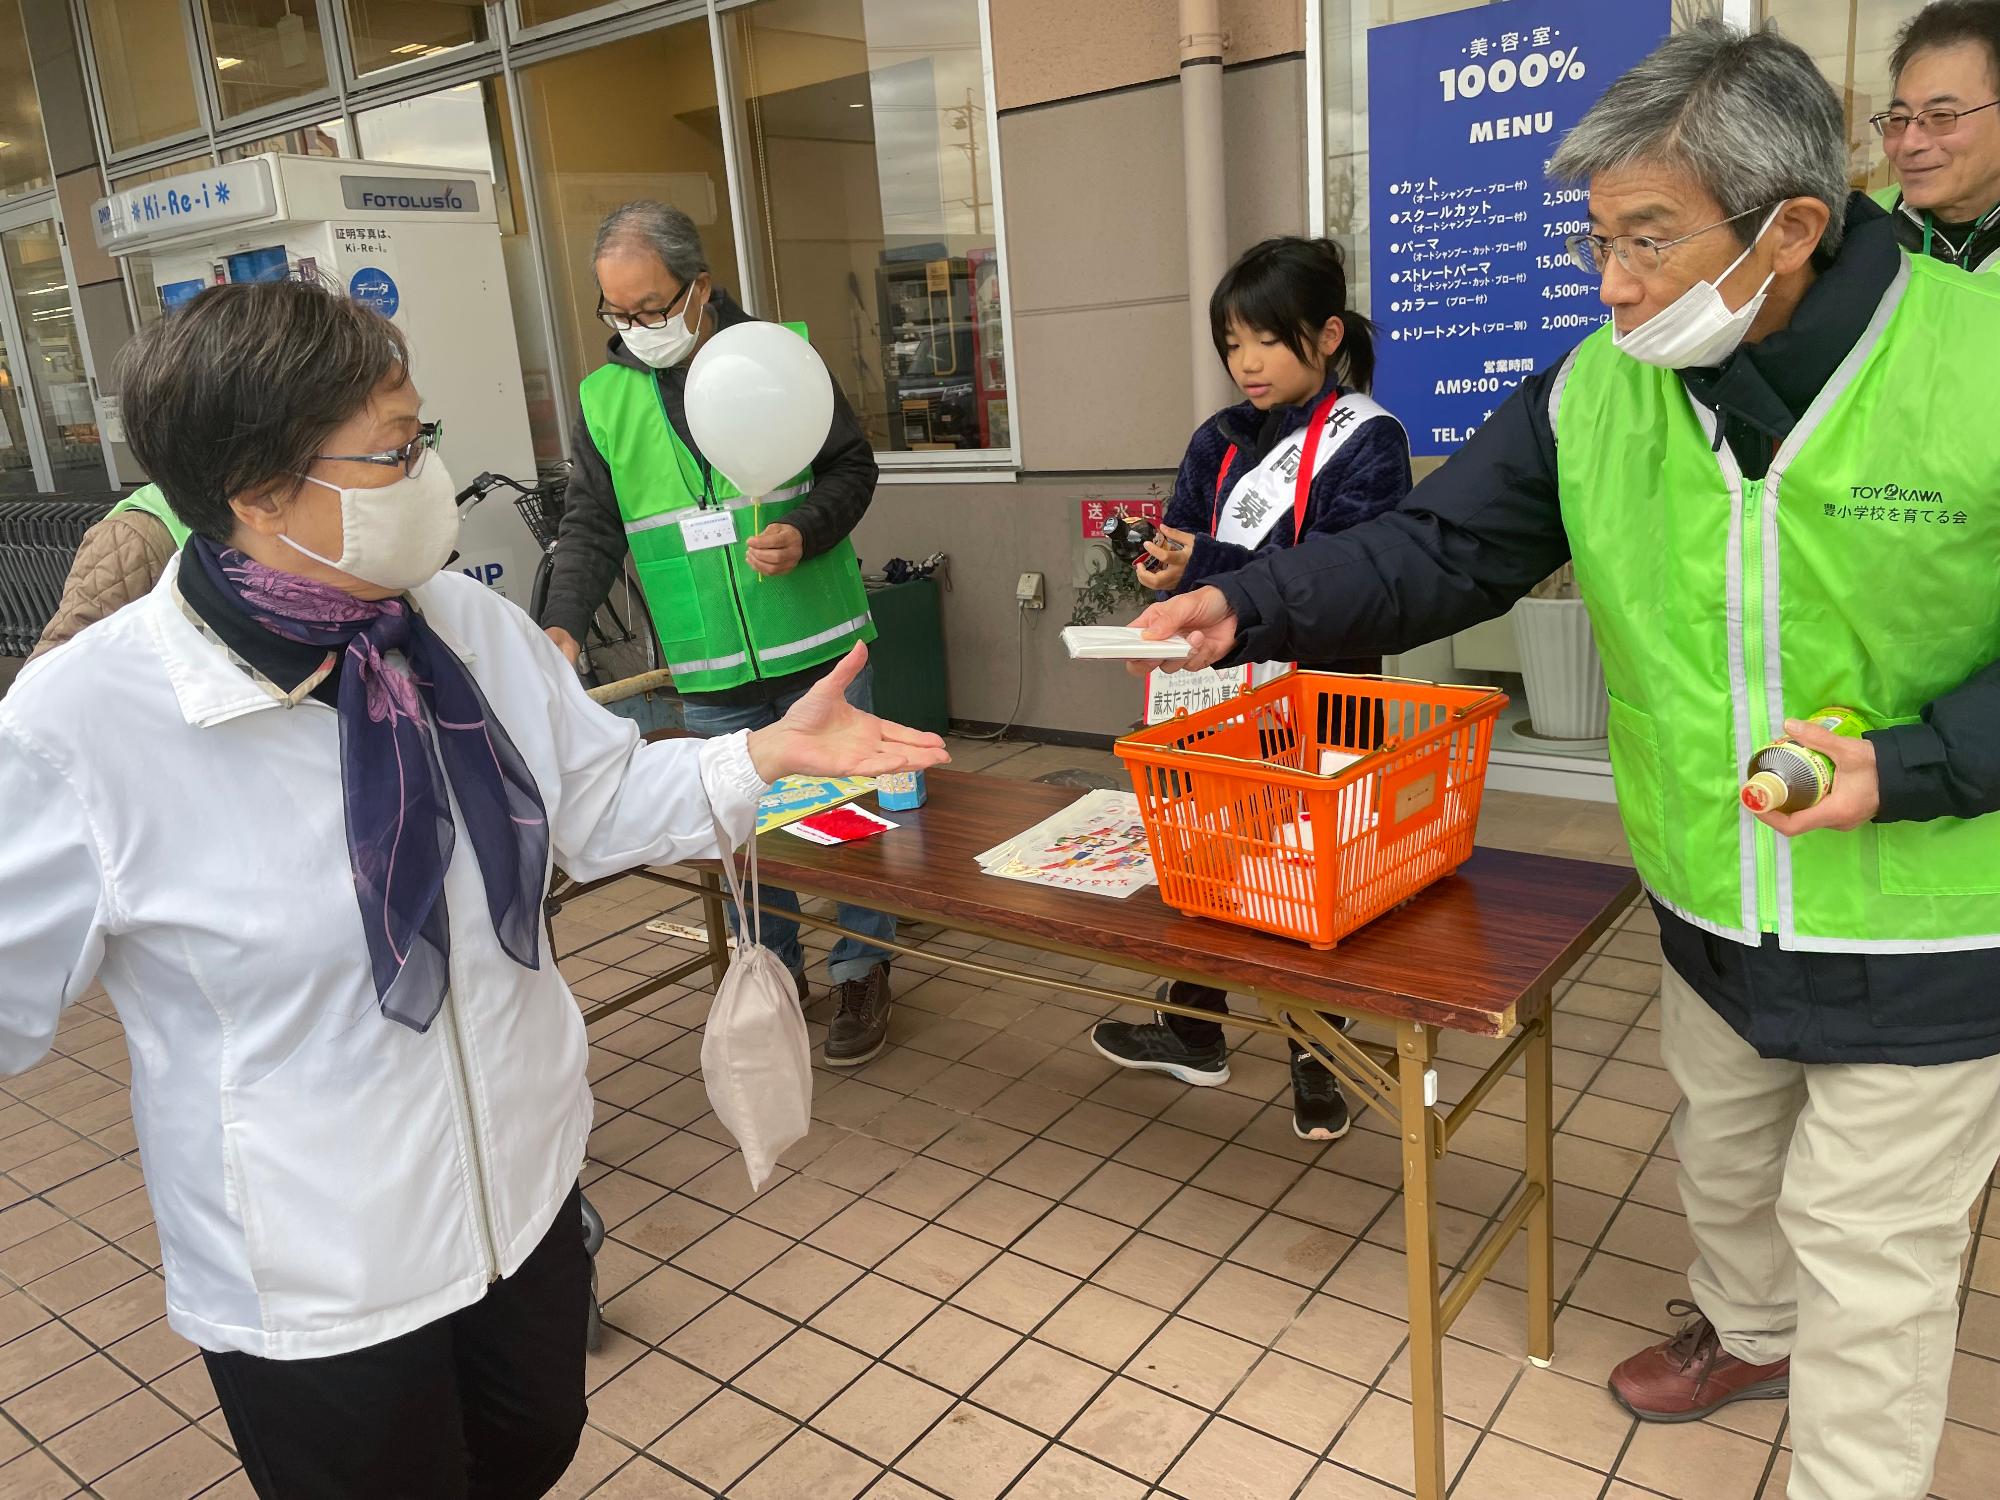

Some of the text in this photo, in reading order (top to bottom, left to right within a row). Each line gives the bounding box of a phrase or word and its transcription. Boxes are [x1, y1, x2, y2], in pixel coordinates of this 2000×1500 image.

[1439, 46, 1586, 102] 1000%
[1469, 111, 1553, 144] MENU
[1400, 177, 1438, 195] カット
[1400, 200, 1492, 224] スクールカット
[1400, 238, 1440, 254] パーマ
[1401, 261, 1492, 283] ストレートパーマ
[356, 282, 389, 296] データ
[1401, 298, 1439, 313] カラー
[1483, 357, 1534, 374] 営業時間
